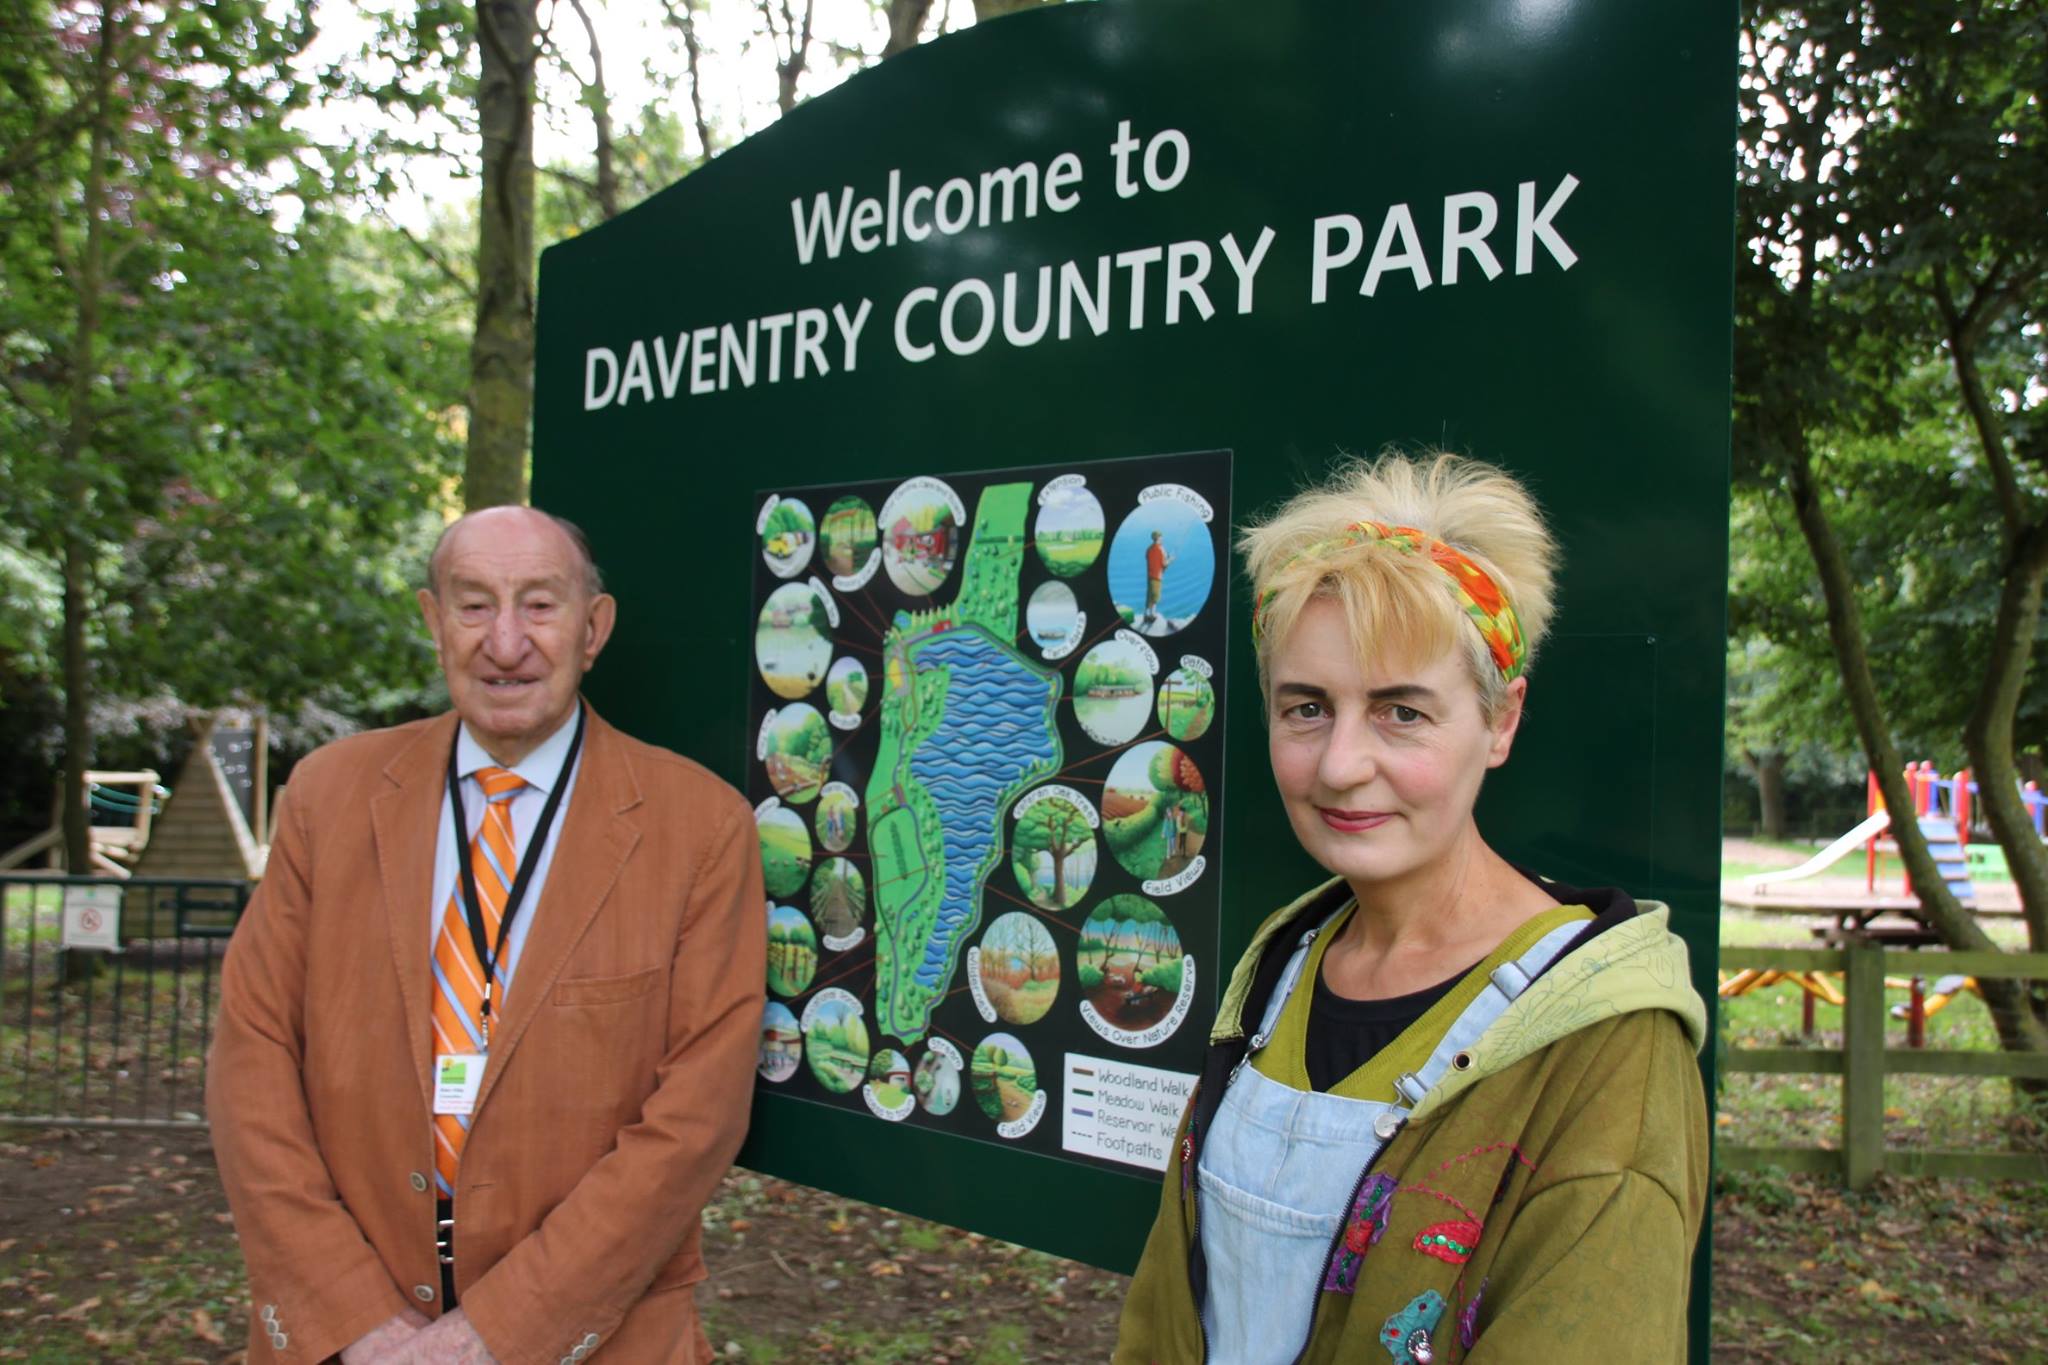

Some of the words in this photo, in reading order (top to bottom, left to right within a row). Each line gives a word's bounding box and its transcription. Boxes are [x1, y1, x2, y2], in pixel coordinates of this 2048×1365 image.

[791, 152, 1083, 265] Welcome
[1110, 120, 1190, 199] to
[584, 298, 873, 411] DAVENTRY
[894, 226, 1276, 363] COUNTRY
[1311, 173, 1580, 304] PARK
[1038, 476, 1083, 502] Extension
[1141, 485, 1172, 501] Public
[1176, 487, 1211, 519] Fishing
[1052, 785, 1072, 799] Oak
[1074, 794, 1098, 826] Trees
[1145, 881, 1172, 895] Field
[1176, 859, 1205, 887] Views
[968, 950, 993, 1021] Wilderness
[1082, 1002, 1109, 1037] Views
[1112, 1030, 1139, 1044] Over
[1142, 1017, 1178, 1044] Nature
[1174, 958, 1194, 1015] Reserve
[1098, 1068, 1158, 1093] Woodland
[1161, 1077, 1189, 1097] Walk
[1000, 1124, 1026, 1137] Field
[1027, 1092, 1047, 1123] Views
[1097, 1089, 1145, 1112] Meadow
[1149, 1098, 1180, 1118] Walk
[1097, 1109, 1154, 1134] Reservoir
[1160, 1119, 1177, 1138] Wa
[1096, 1131, 1163, 1161] Footpaths
